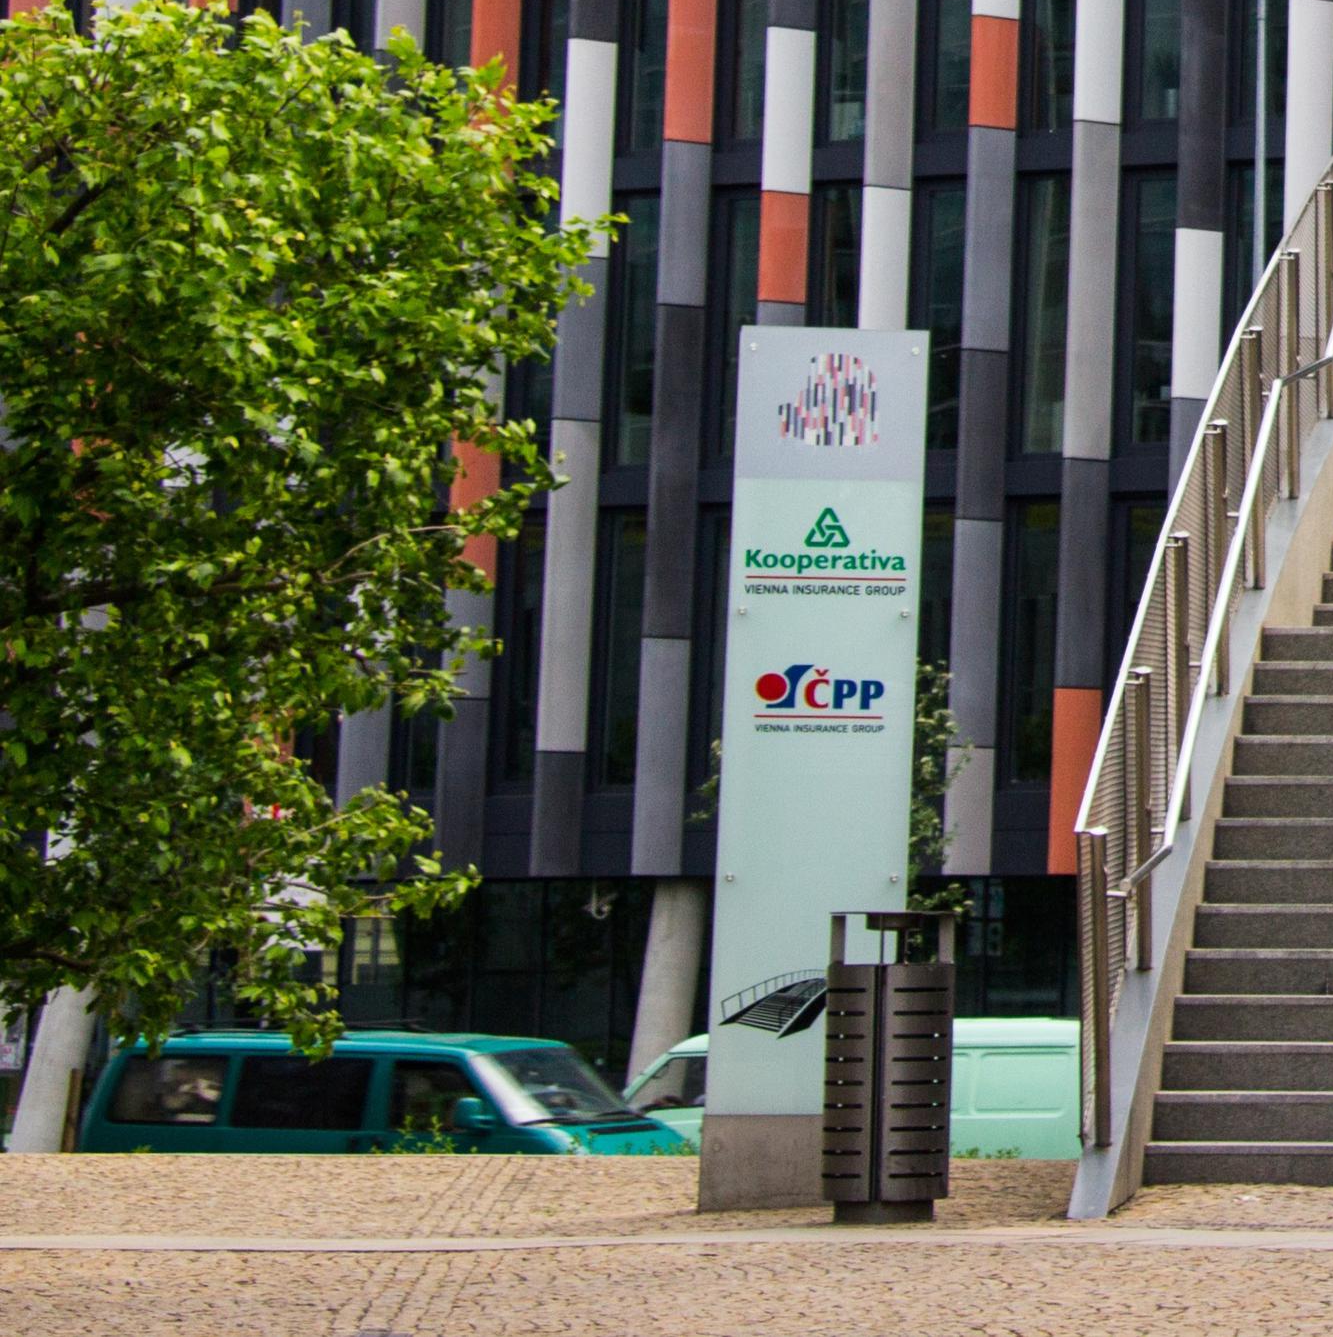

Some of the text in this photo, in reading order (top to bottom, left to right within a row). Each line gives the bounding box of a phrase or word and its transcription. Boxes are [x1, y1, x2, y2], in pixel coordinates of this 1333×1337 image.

[745, 549, 907, 574] Kooperativa
[744, 584, 906, 596] VIENNA INSURANCE GROUP
[804, 669, 885, 710] ČPP
[754, 724, 885, 734] VIENNA INSURANCE GROUP
